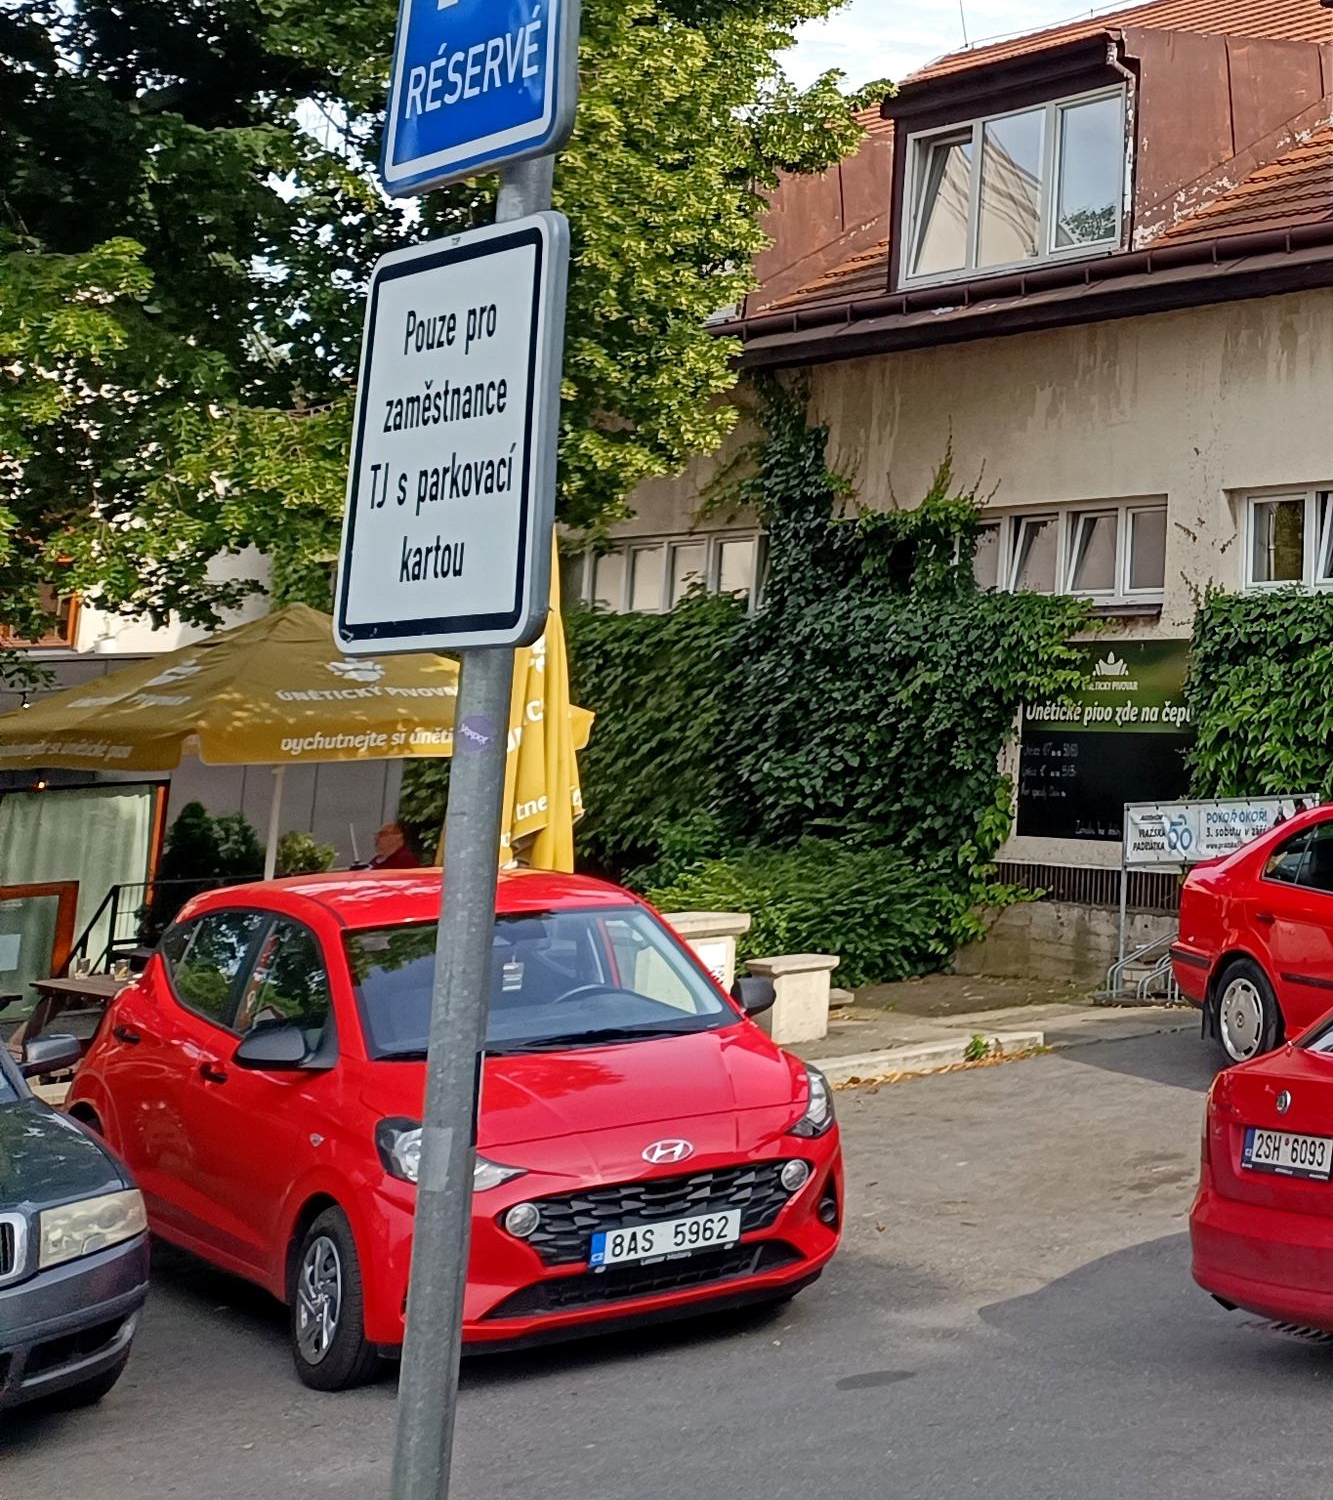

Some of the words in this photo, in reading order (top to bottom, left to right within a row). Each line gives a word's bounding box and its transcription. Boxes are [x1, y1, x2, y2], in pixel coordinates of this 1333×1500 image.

[404, 5, 541, 119] RÉSERVÉ
[403, 308, 456, 356] Pouze
[464, 302, 497, 355] pro
[383, 377, 507, 433] zaměstnance
[370, 462, 389, 510] TJ
[396, 473, 407, 506] s
[415, 442, 516, 516] parkovací
[398, 535, 464, 582] kartou
[276, 684, 384, 701] ÚNĚTICKÝ
[384, 686, 459, 697] PIVOVA
[1083, 700, 1113, 727] pivo
[1115, 699, 1139, 726] zde
[1141, 706, 1160, 722] na
[281, 731, 387, 756] vychutnejte
[390, 728, 407, 746] si
[409, 726, 454, 745] úněti
[1206, 809, 1238, 824] POKOŘ
[1206, 826, 1213, 838] 3.
[1215, 825, 1242, 837] sobotu
[1244, 827, 1249, 836] v
[1255, 1133, 1282, 1162] 2SH
[1290, 1138, 1326, 1167] 6093
[611, 1228, 655, 1258] 8AS
[673, 1215, 729, 1247] 5962
